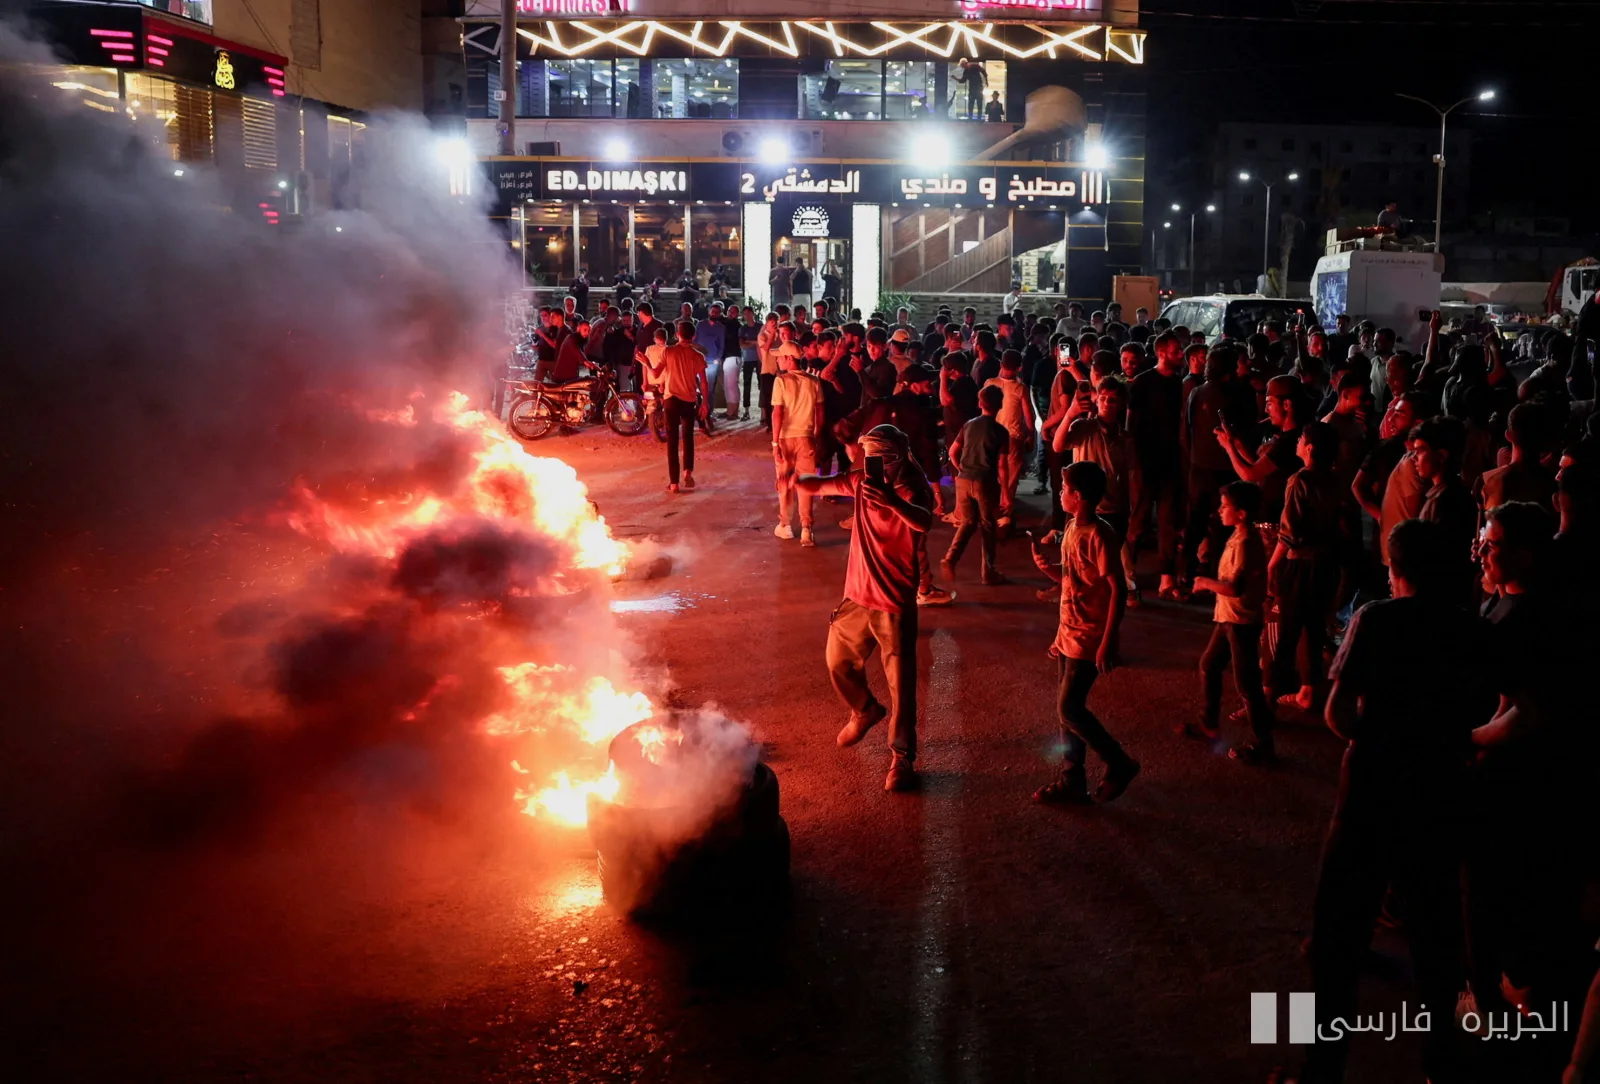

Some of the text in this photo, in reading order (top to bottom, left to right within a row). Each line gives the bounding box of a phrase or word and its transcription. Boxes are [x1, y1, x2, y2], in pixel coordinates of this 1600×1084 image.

[548, 170, 687, 195] ED.DIMAŞKI
[741, 167, 1076, 202] مطبخ و مندي الدمشقي 2
